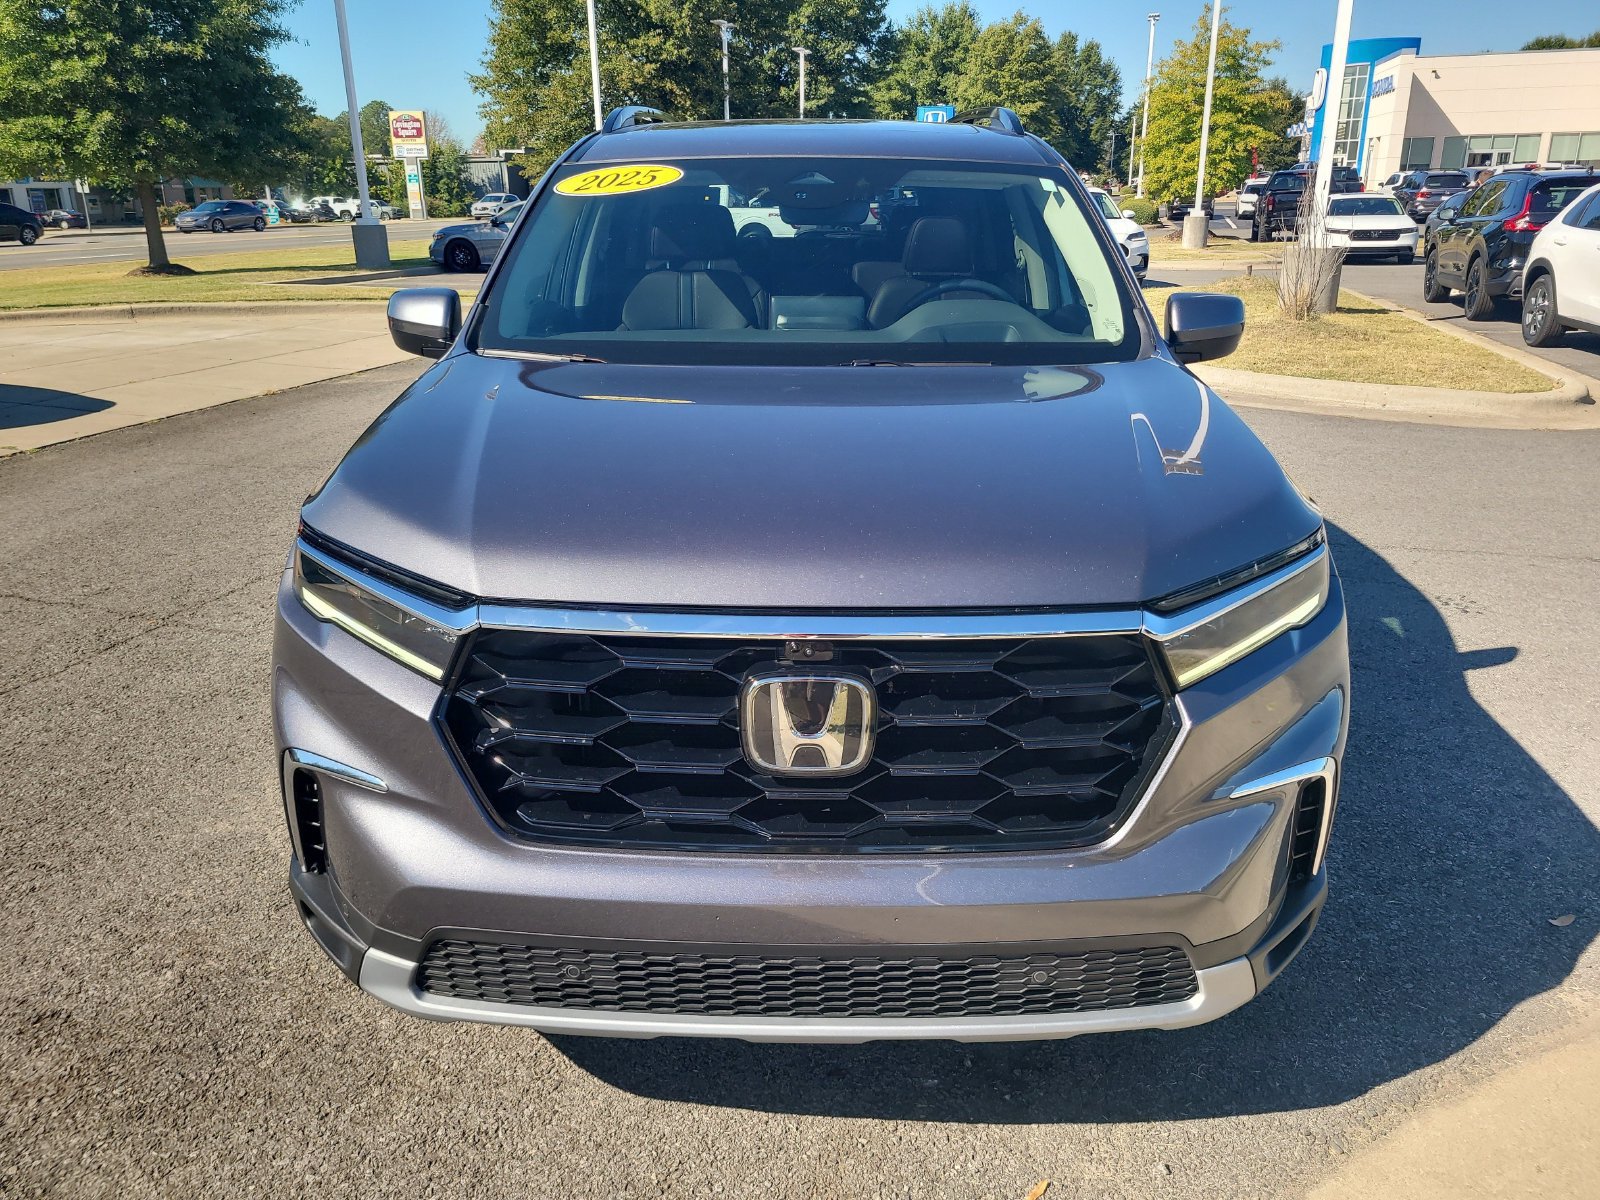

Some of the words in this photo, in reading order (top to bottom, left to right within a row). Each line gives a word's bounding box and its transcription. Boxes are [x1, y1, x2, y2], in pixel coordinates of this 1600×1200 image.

[393, 120, 421, 129] Covington
[398, 128, 418, 137] Square
[574, 169, 662, 192] 2025
